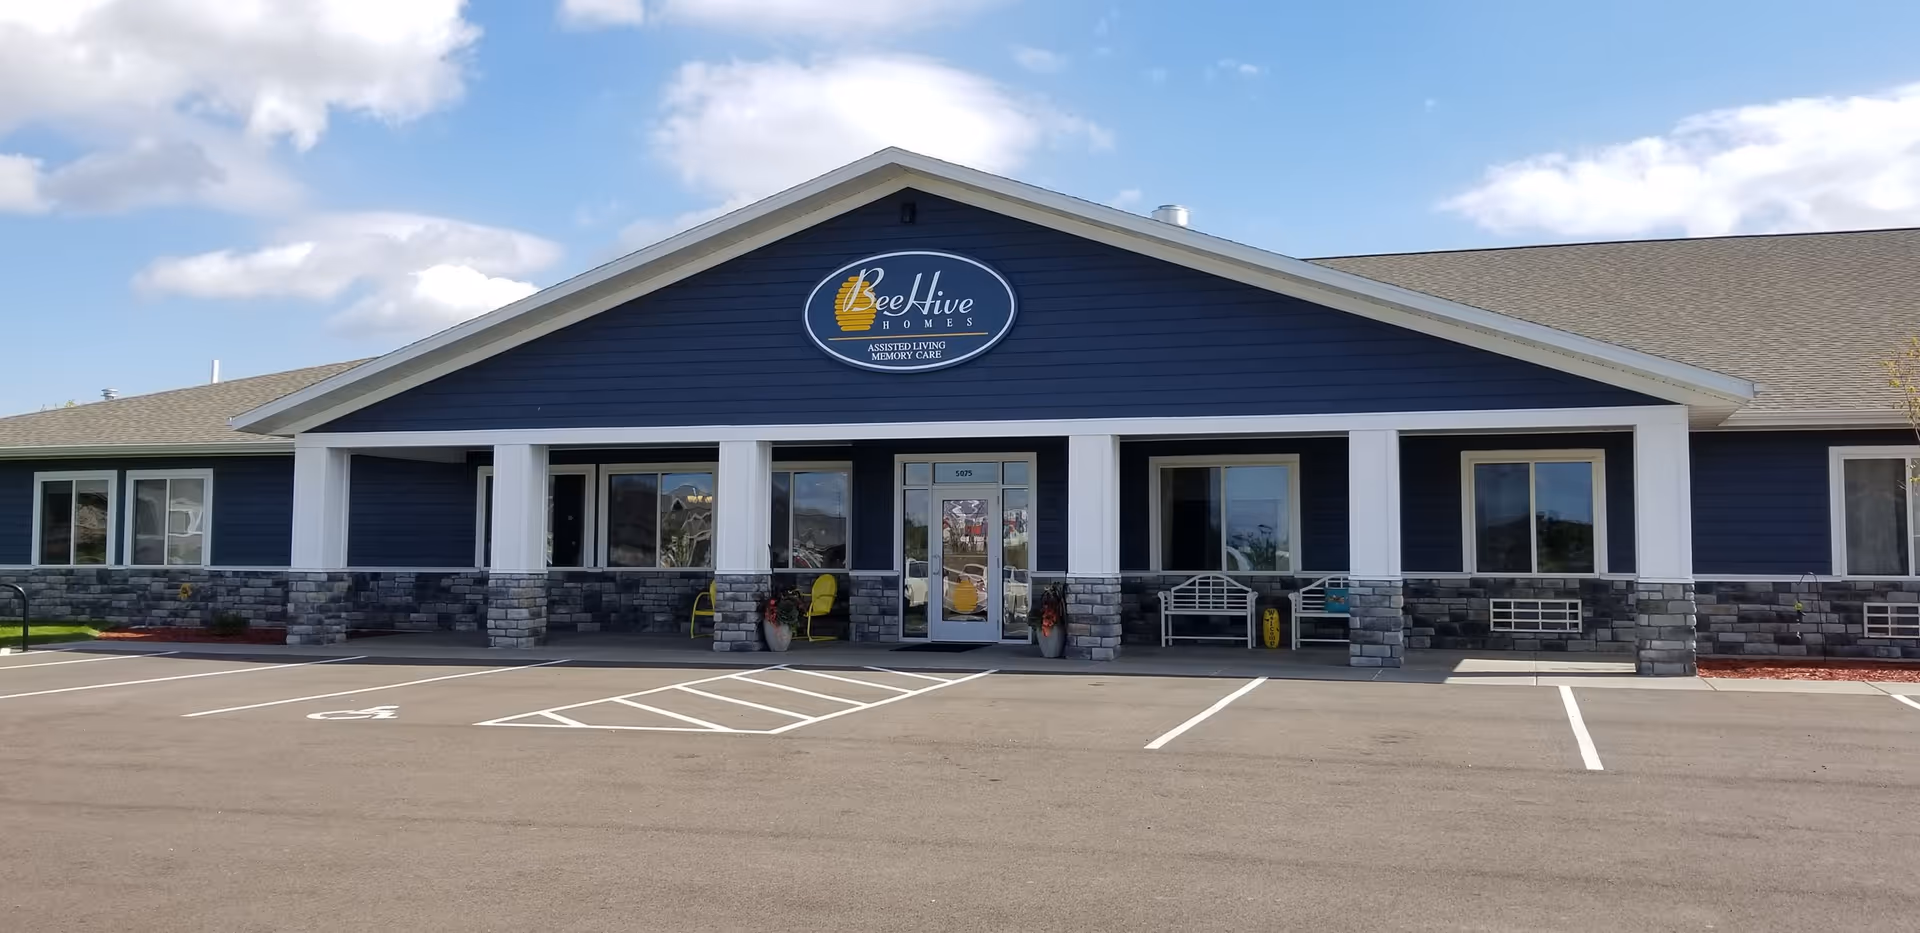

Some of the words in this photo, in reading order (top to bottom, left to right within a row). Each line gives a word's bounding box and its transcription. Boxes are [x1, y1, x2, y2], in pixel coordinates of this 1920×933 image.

[842, 267, 974, 317] BeeHive
[882, 317, 973, 330] HOMES
[867, 342, 911, 352] ASSISTED
[913, 341, 946, 351] LIVING
[871, 351, 913, 361] MEMORY
[915, 350, 942, 359] CARE
